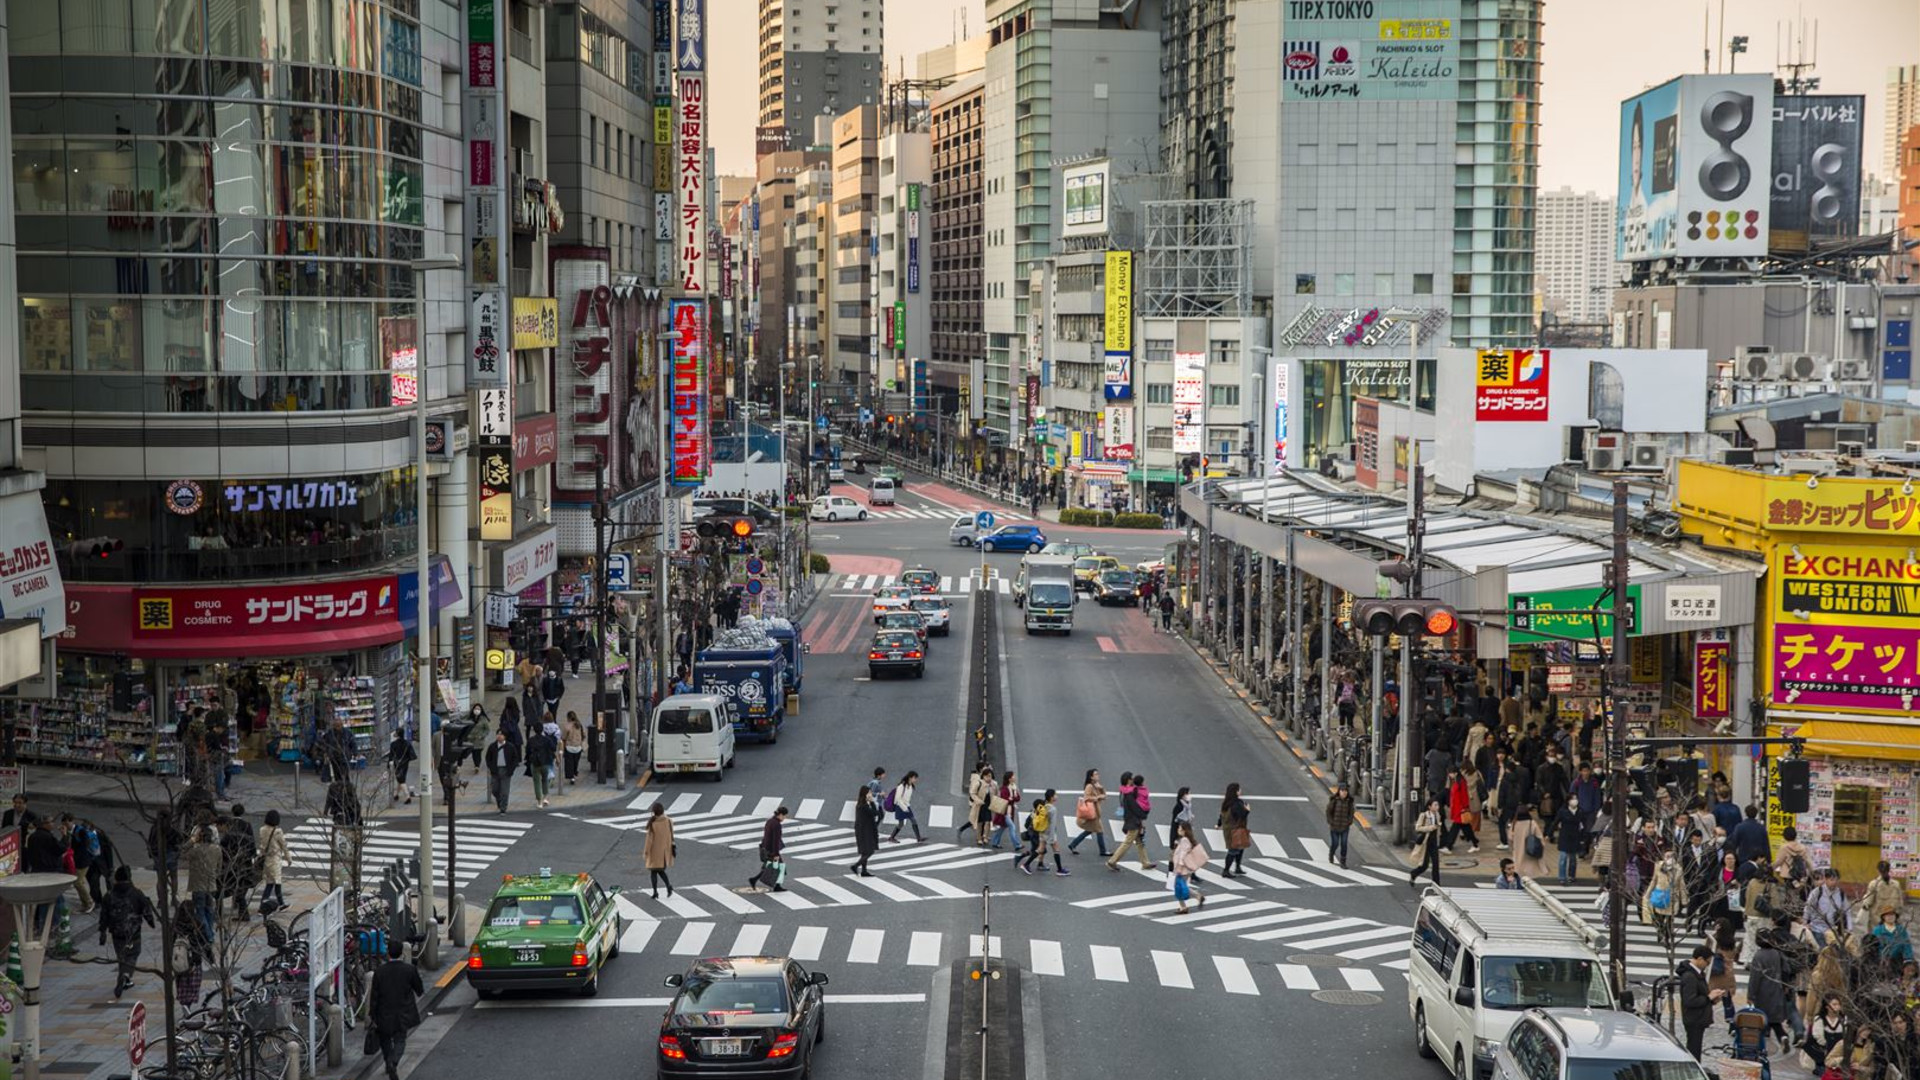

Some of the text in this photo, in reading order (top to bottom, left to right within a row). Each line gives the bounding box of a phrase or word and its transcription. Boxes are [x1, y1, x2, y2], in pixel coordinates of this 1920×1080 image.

[1328, 1, 1373, 19] TOKYO
[1367, 56, 1452, 79] Kaleido
[680, 79, 701, 291] 100名収容大パーティールーム
[1118, 257, 1128, 291] Money
[572, 285, 612, 474] パチンコ
[1342, 369, 1411, 386] Kaleido
[1482, 354, 1508, 382] 薬
[1478, 396, 1547, 411] サンドラッグ
[489, 436, 501, 444] B1
[225, 480, 358, 512] サンマルクカフェ
[1768, 488, 1920, 531] 金券ショップビッ
[0, 540, 51, 577] ビックカメラ
[13, 576, 50, 598] BIC CAMERA
[1789, 582, 1892, 598] WESTERN
[143, 601, 171, 627] 薬
[194, 600, 222, 610] DRUG
[246, 589, 368, 624] サンドラッグ
[1820, 597, 1891, 613] UNION
[184, 615, 232, 626] COSMETIC
[1780, 633, 1920, 675] チケッ
[702, 685, 736, 697] BOSS
[1700, 648, 1718, 711] チケット
